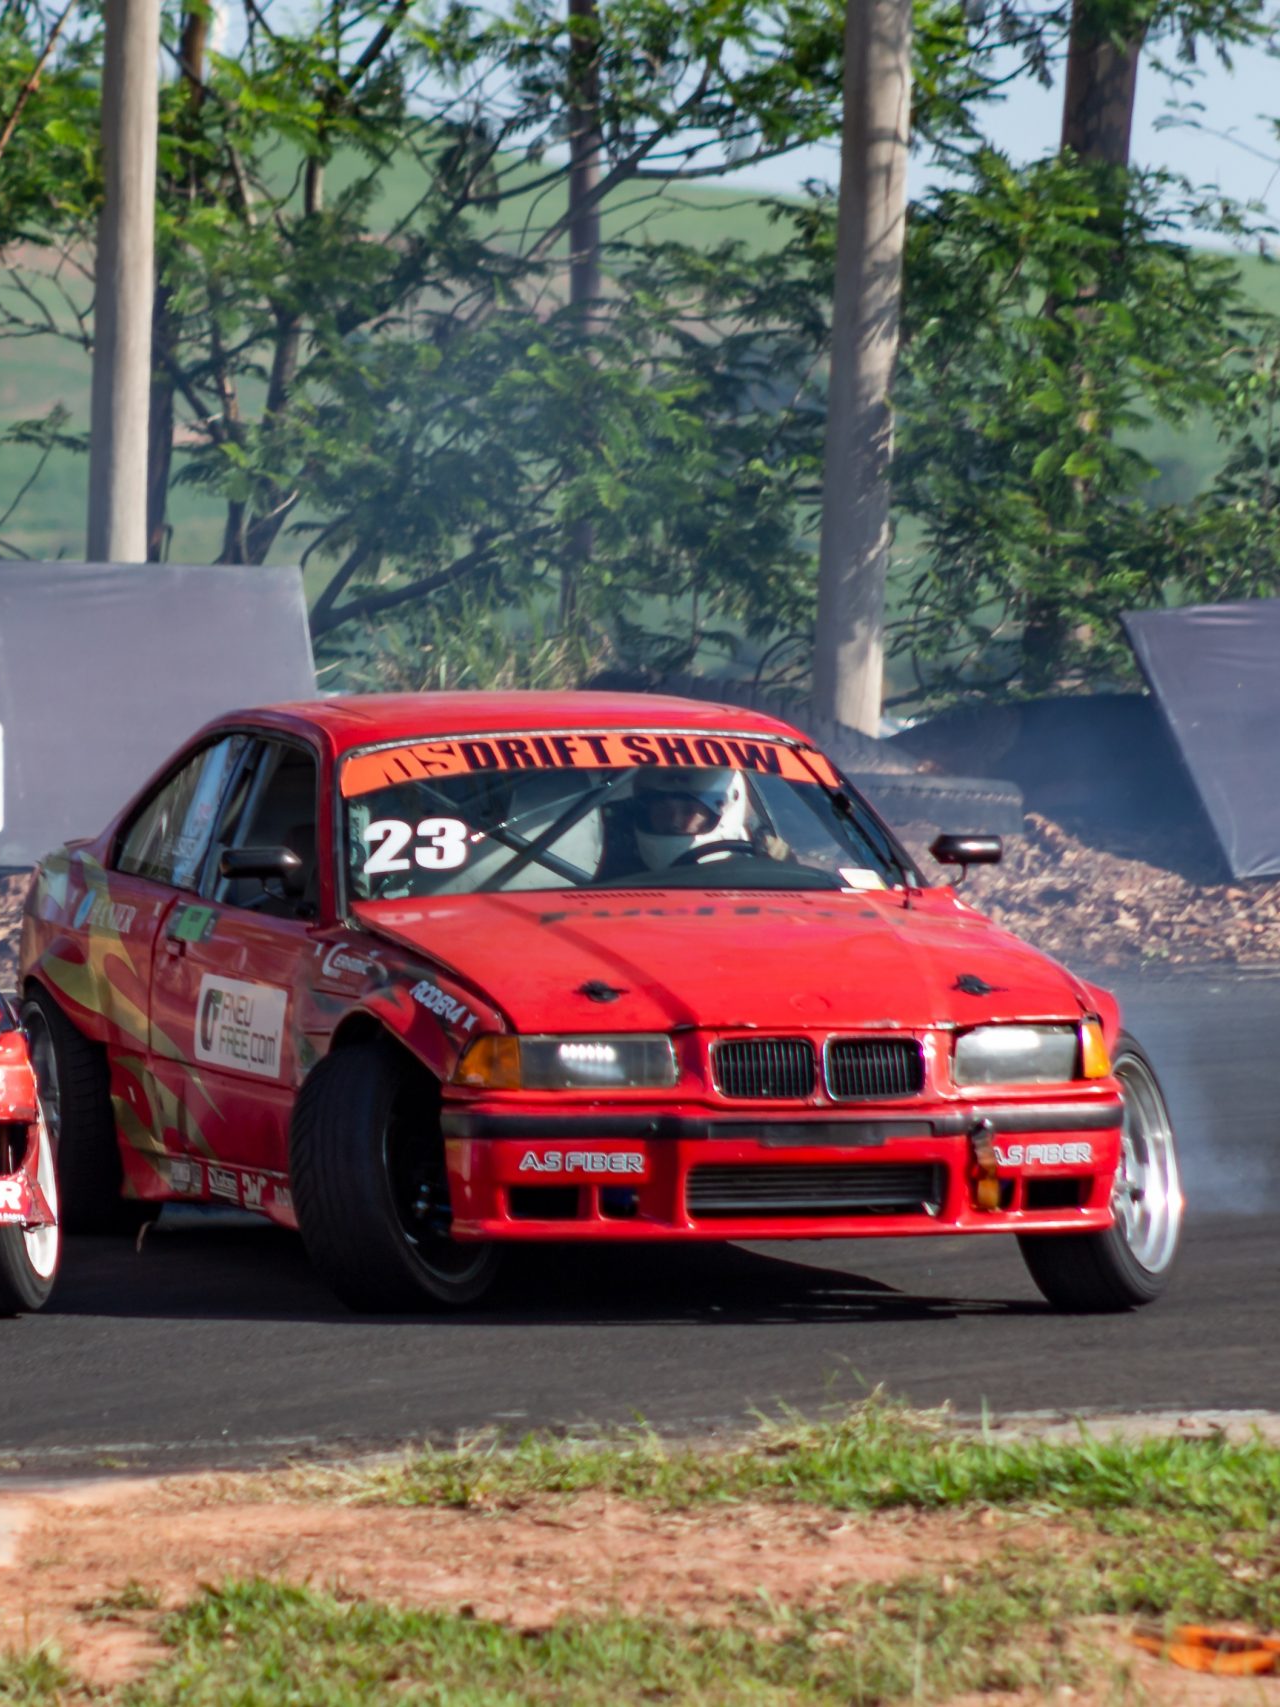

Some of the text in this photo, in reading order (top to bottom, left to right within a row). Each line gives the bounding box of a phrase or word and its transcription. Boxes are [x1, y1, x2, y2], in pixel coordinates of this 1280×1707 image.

[621, 735, 784, 775] SHOW
[363, 817, 468, 875] 23
[565, 1151, 645, 1173] FIBER
[1025, 1142, 1093, 1166] FIBER
